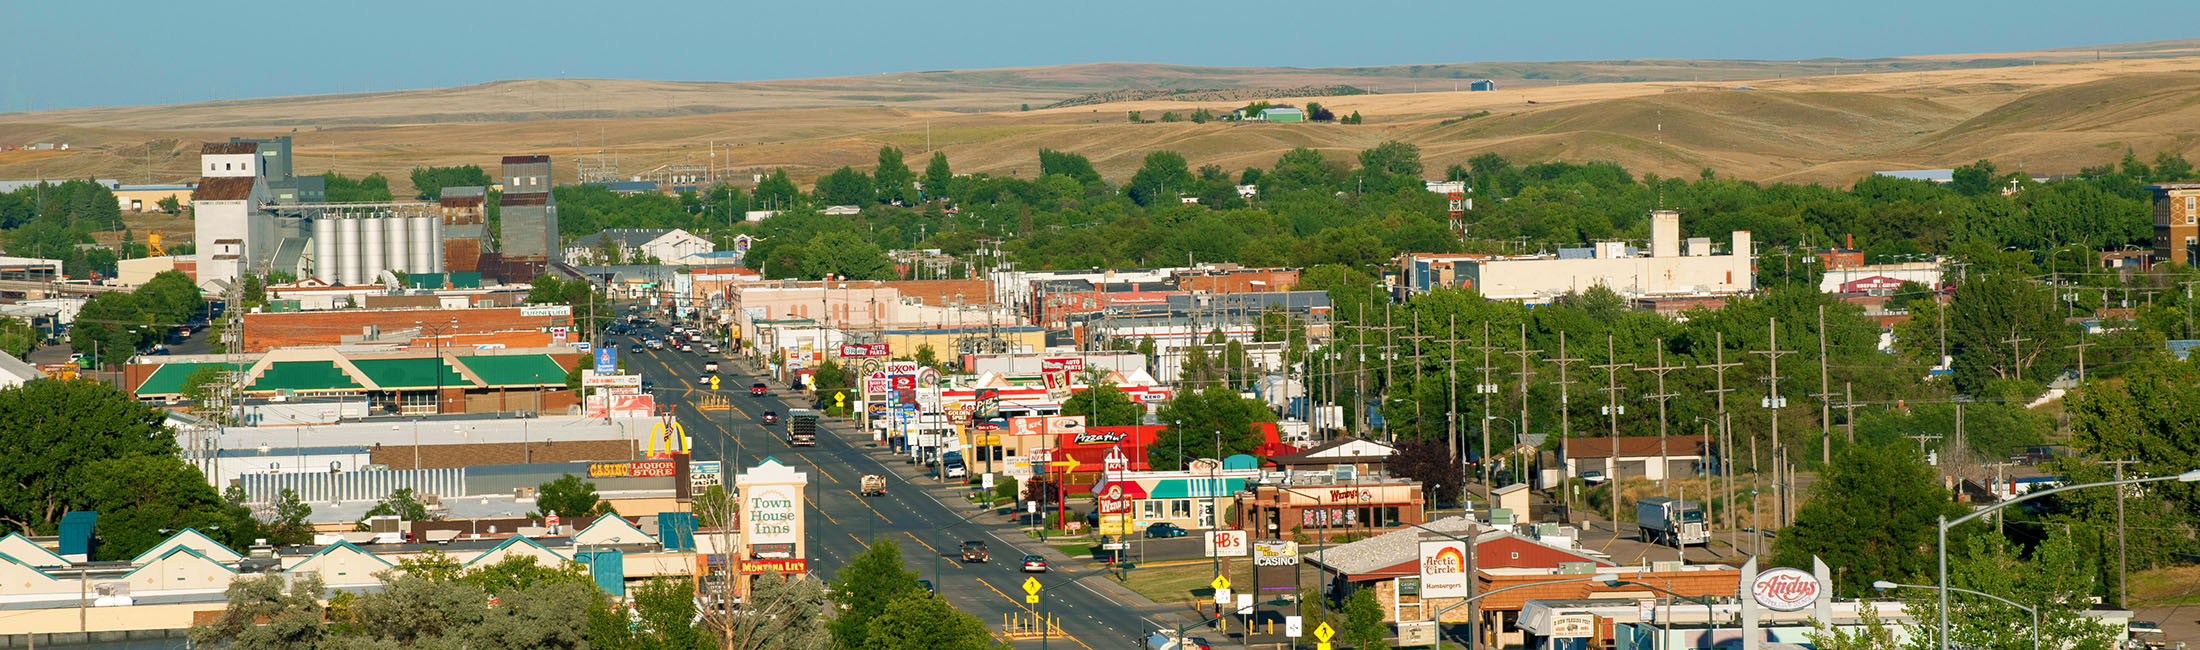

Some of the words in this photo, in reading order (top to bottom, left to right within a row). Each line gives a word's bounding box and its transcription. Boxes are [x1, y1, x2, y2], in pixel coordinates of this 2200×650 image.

[888, 364, 916, 375] EXXON
[869, 384, 886, 393] CASIN
[1028, 419, 1043, 429] KFC
[1074, 432, 1102, 443] Pizza
[1103, 431, 1128, 442] Hut
[590, 463, 629, 477] CASINO
[632, 462, 674, 470] LIQUOR
[632, 468, 674, 476] STORE
[751, 497, 792, 508] Town
[750, 510, 795, 521] House
[755, 523, 790, 534] Inns
[1258, 556, 1295, 567] CASINO
[1423, 555, 1456, 568] Arctic
[1425, 566, 1456, 575] Circle
[1754, 574, 1817, 603] Andys
